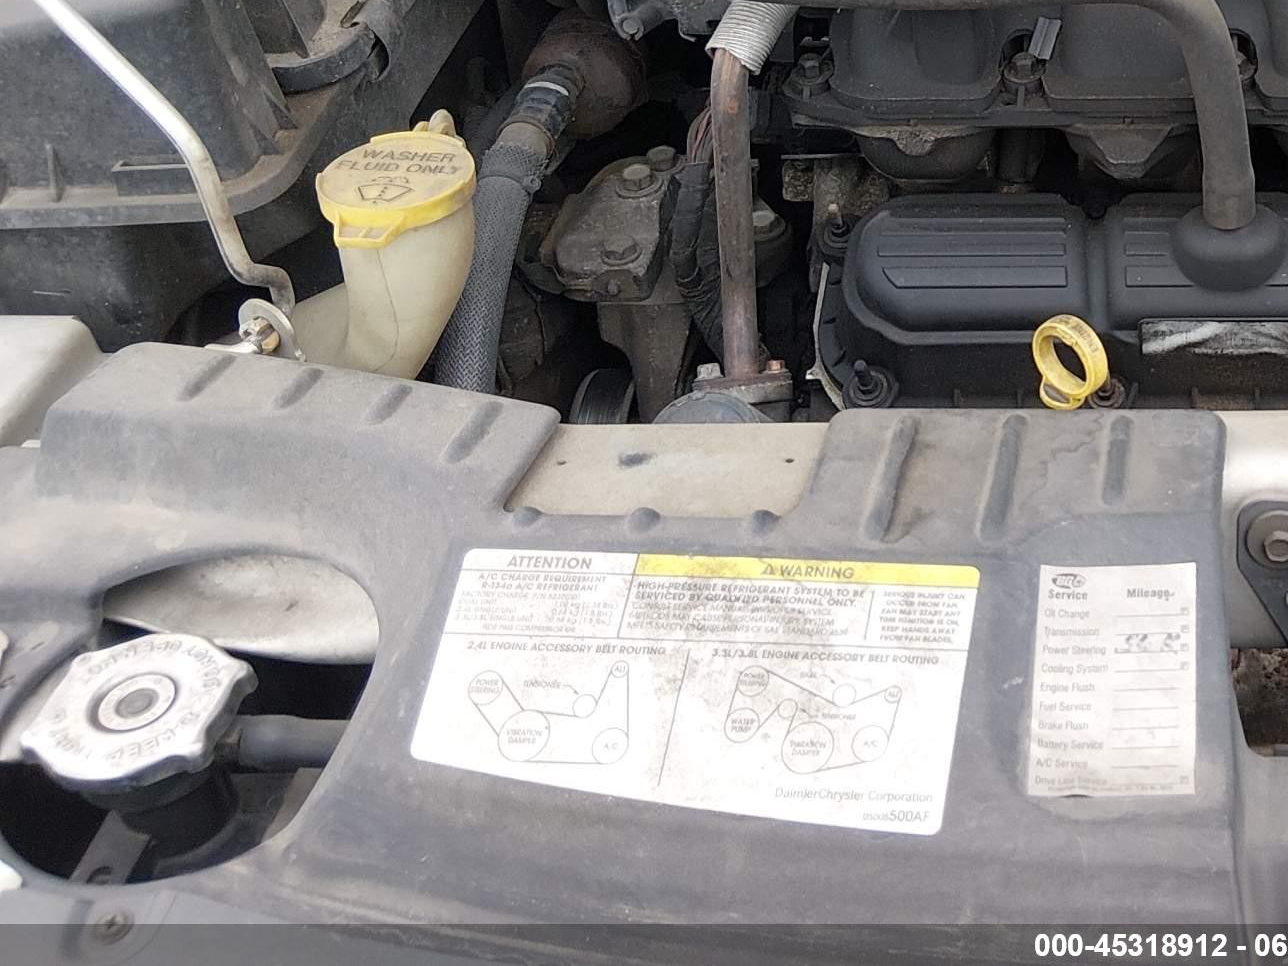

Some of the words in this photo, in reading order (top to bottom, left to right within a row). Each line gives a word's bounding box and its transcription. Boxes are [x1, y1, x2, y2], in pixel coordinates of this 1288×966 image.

[362, 149, 457, 163] WASHER
[335, 160, 400, 174] FLUID
[406, 163, 462, 175] ONLY
[507, 555, 593, 570] ATTENTION
[778, 564, 856, 579] WARNING
[499, 573, 540, 582] CHARGE
[544, 574, 607, 584] REQUIREMENT
[536, 583, 599, 592] REFRIGERANT
[720, 584, 791, 595] REFRIGERANT
[794, 586, 833, 597] SYSTEM
[836, 588, 850, 597] TO
[852, 588, 866, 598] BE
[634, 591, 686, 602] SERVICED
[688, 593, 701, 602] BY
[762, 596, 823, 606] PERSONNEL
[827, 597, 857, 608] ONLY.
[1048, 589, 1088, 601] Service
[1058, 609, 1090, 620] Change
[1044, 626, 1100, 636] Transmission
[467, 641, 489, 651] 2.4L
[490, 641, 528, 652] ENGINE
[530, 642, 592, 654] ACCESSORY
[595, 643, 618, 655] BELT
[618, 645, 667, 656] ROUTING
[1042, 645, 1070, 655] Power
[1071, 645, 1107, 657] Steering
[761, 649, 800, 660] ENGINE
[802, 651, 864, 663] ACCESSORY
[868, 652, 889, 663] BELT
[892, 654, 940, 666] ROUTING
[1041, 664, 1074, 676] Cooling
[1076, 664, 1109, 675] System
[1040, 682, 1069, 694] Engine
[1072, 682, 1095, 693] Flush
[1039, 701, 1057, 712] Fuel
[1059, 701, 1092, 712] Service
[1038, 721, 1063, 731] Brake
[1065, 720, 1089, 731] Flush
[1037, 738, 1069, 751] Battery
[1071, 739, 1104, 751] Service
[1035, 757, 1052, 768] A/C
[1055, 758, 1089, 770] Service
[1035, 775, 1056, 785] Drive
[775, 787, 865, 803] DaimlerChrysler
[868, 790, 933, 804] Corporation
